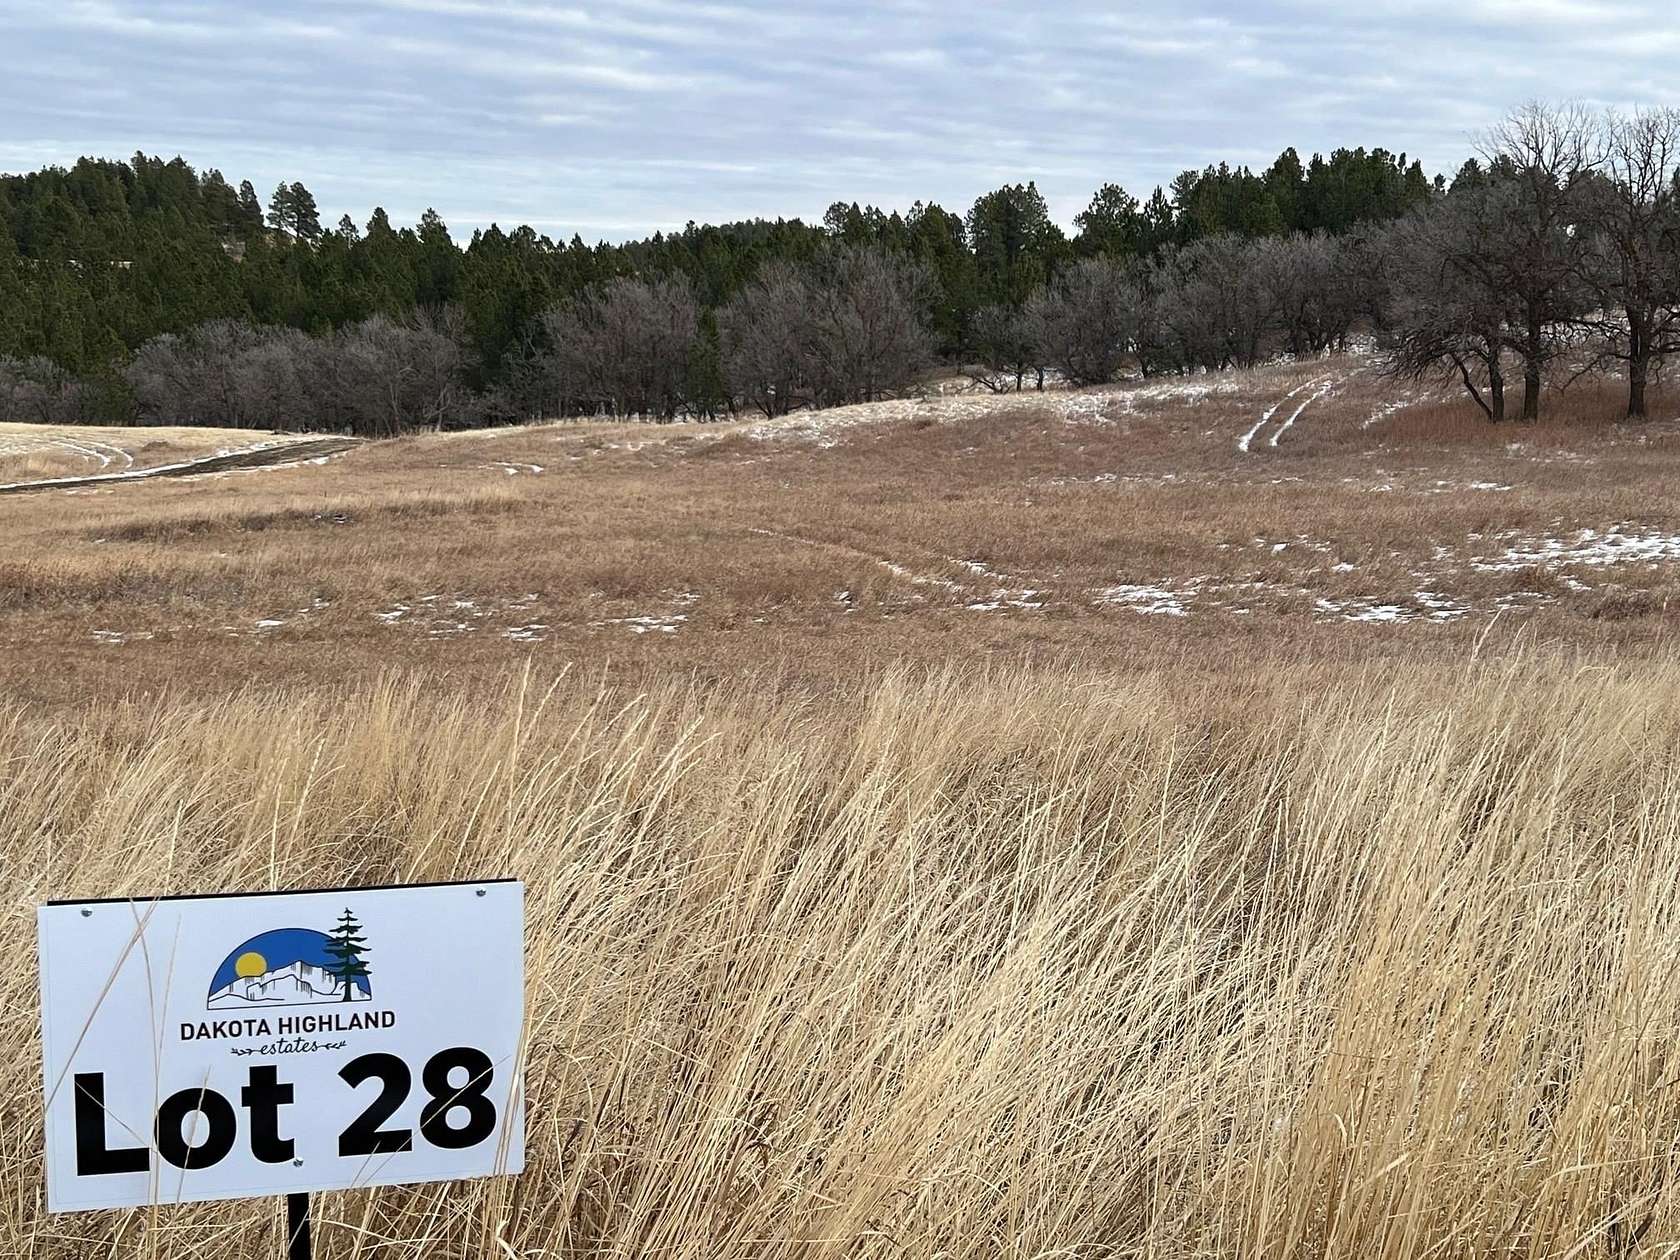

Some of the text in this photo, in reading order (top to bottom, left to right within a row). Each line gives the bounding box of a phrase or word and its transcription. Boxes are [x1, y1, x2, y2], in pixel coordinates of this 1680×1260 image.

[180, 1010, 396, 1041] DAKOTA HIGHLAND
[260, 1036, 320, 1056] estates
[73, 1046, 498, 1177] Lot 28
